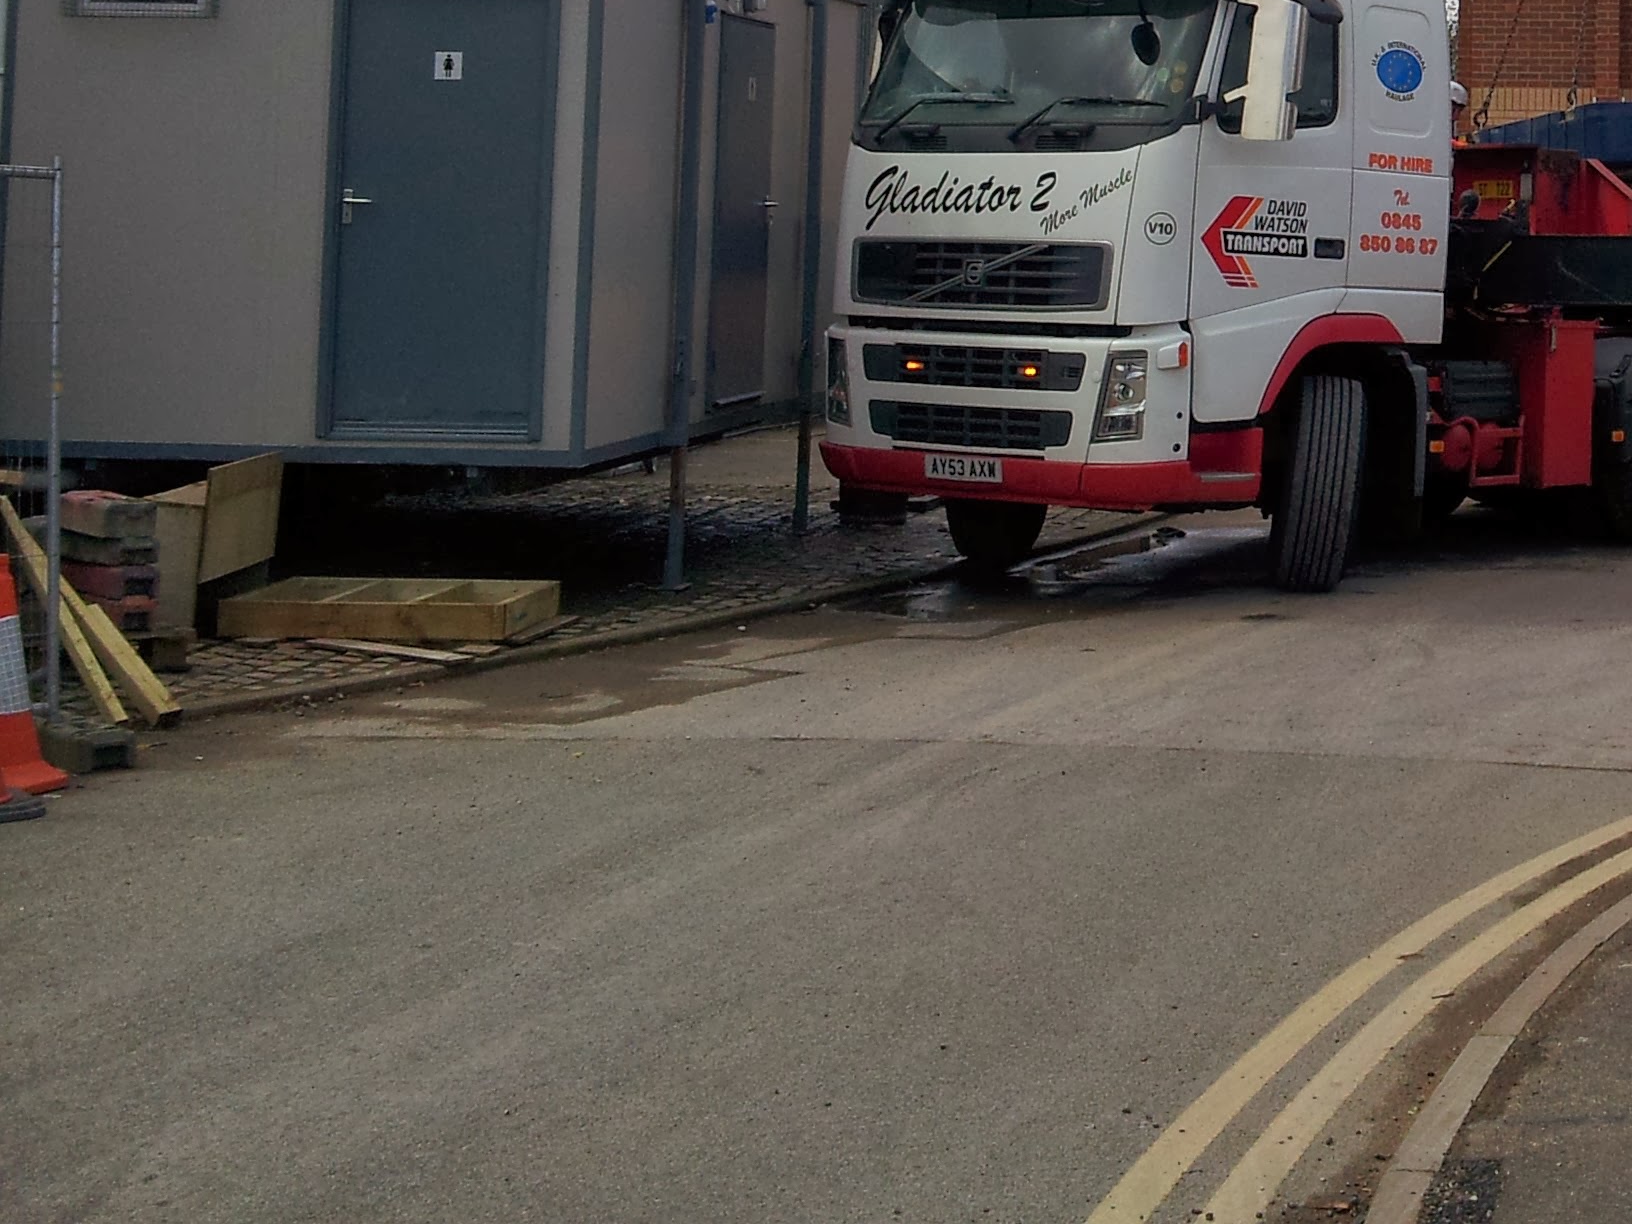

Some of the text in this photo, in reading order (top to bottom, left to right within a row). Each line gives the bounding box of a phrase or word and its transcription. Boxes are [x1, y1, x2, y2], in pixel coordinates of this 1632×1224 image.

[1368, 152, 1433, 173] FOR HIRE
[865, 164, 1057, 231] Gladiator 2
[1040, 167, 1132, 236] More Muscle
[1267, 199, 1307, 217] DAVID
[1148, 222, 1173, 236] V10
[1254, 215, 1308, 234] WATSON
[1381, 212, 1422, 231] 0845
[1226, 234, 1305, 255] TRANSPORT
[1360, 234, 1391, 253] 850
[1419, 238, 1438, 256] 87
[931, 457, 997, 478] AY53 AXW
